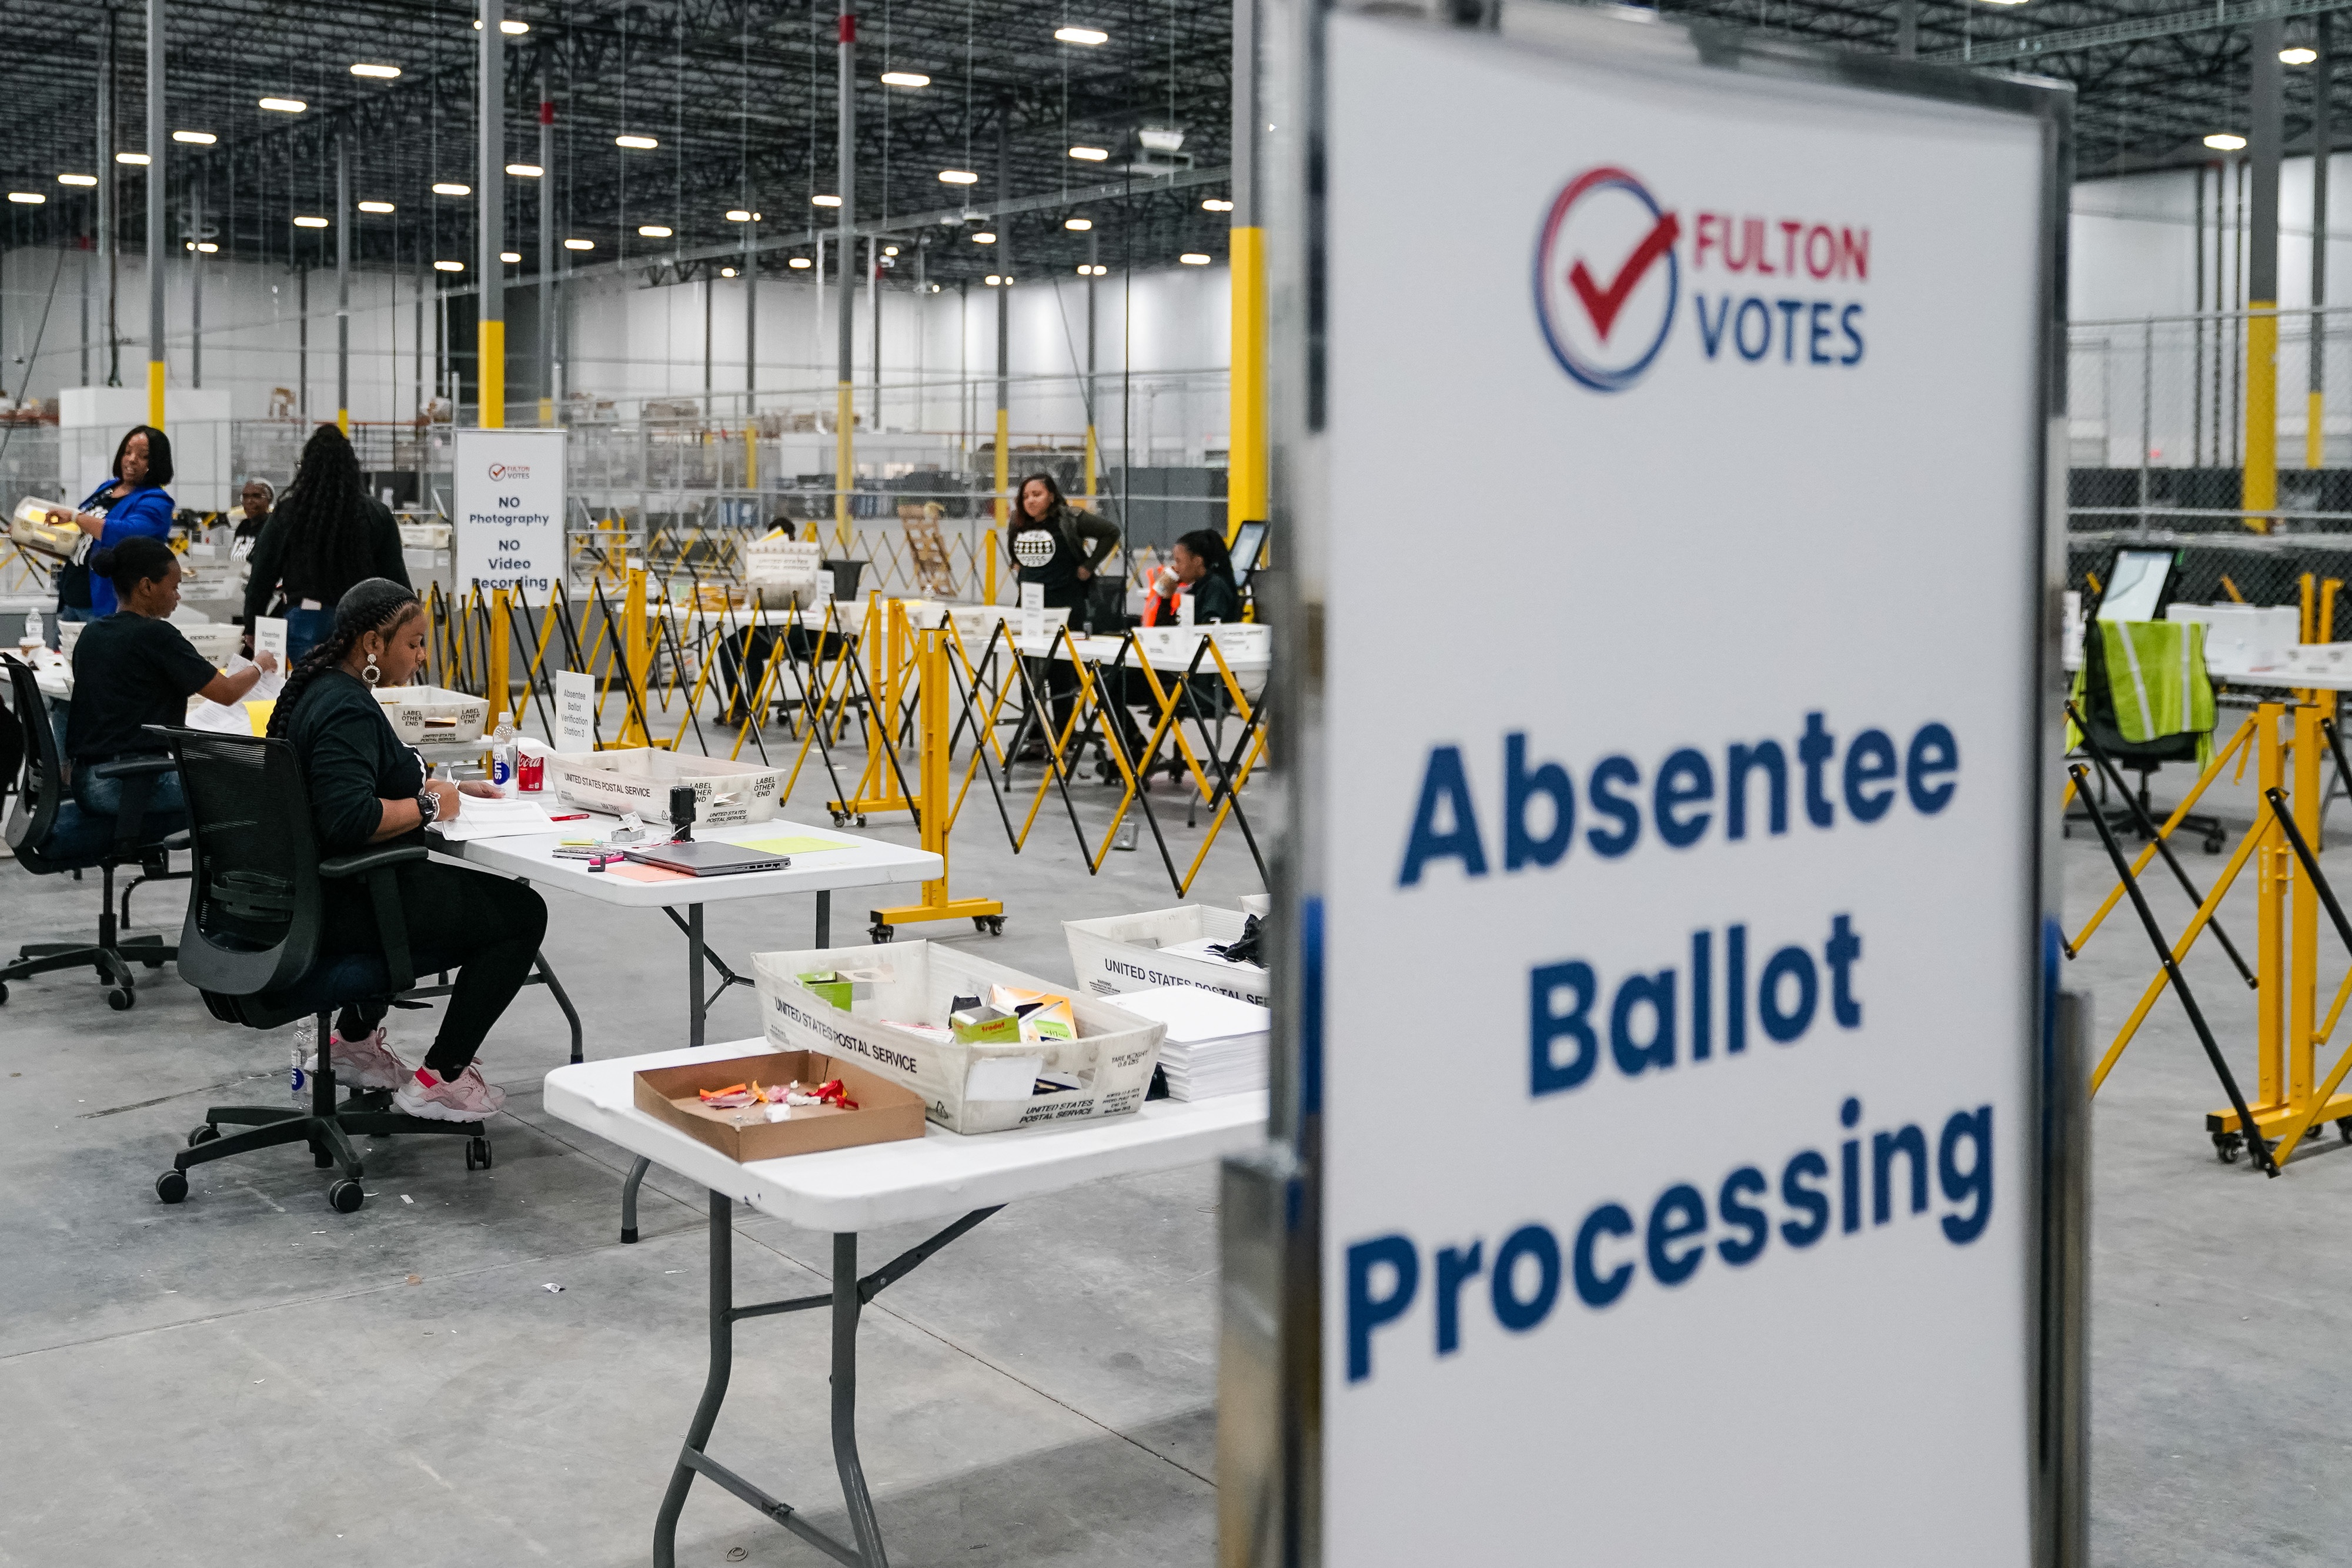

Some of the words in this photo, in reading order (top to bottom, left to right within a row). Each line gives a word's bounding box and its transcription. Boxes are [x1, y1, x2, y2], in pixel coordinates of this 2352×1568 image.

[1696, 213, 1867, 280] FULTON
[1696, 295, 1864, 367] VOTES
[499, 497, 520, 508] NO
[470, 514, 549, 526] Photography
[499, 540, 520, 551] NO
[488, 557, 531, 570] Video
[564, 689, 586, 700] Absentee
[567, 702, 582, 713] Ballot
[560, 713, 589, 726] Verification
[564, 726, 581, 737] Station
[581, 730, 585, 738] 3
[564, 773, 582, 784] UNITED
[582, 777, 602, 790] STATES
[602, 782, 624, 793] POSTAL
[624, 787, 651, 797] SERVICE
[754, 783, 776, 792] OTHER
[756, 776, 776, 785] LABEL
[1398, 710, 1962, 889] Absentee
[1105, 958, 1146, 980] UNITED
[1527, 911, 1864, 1098] Ballot
[774, 997, 801, 1022] UNITED
[802, 1012, 833, 1041] STATES
[833, 1032, 871, 1057] POSTAL
[872, 1045, 917, 1074] SERVICE
[1026, 1104, 1058, 1114] UNITED
[1059, 1099, 1094, 1109] STATES
[1020, 1112, 1054, 1124] POSTAL
[1055, 1107, 1094, 1119] SERVICE
[1343, 1097, 1996, 1386] Processing
